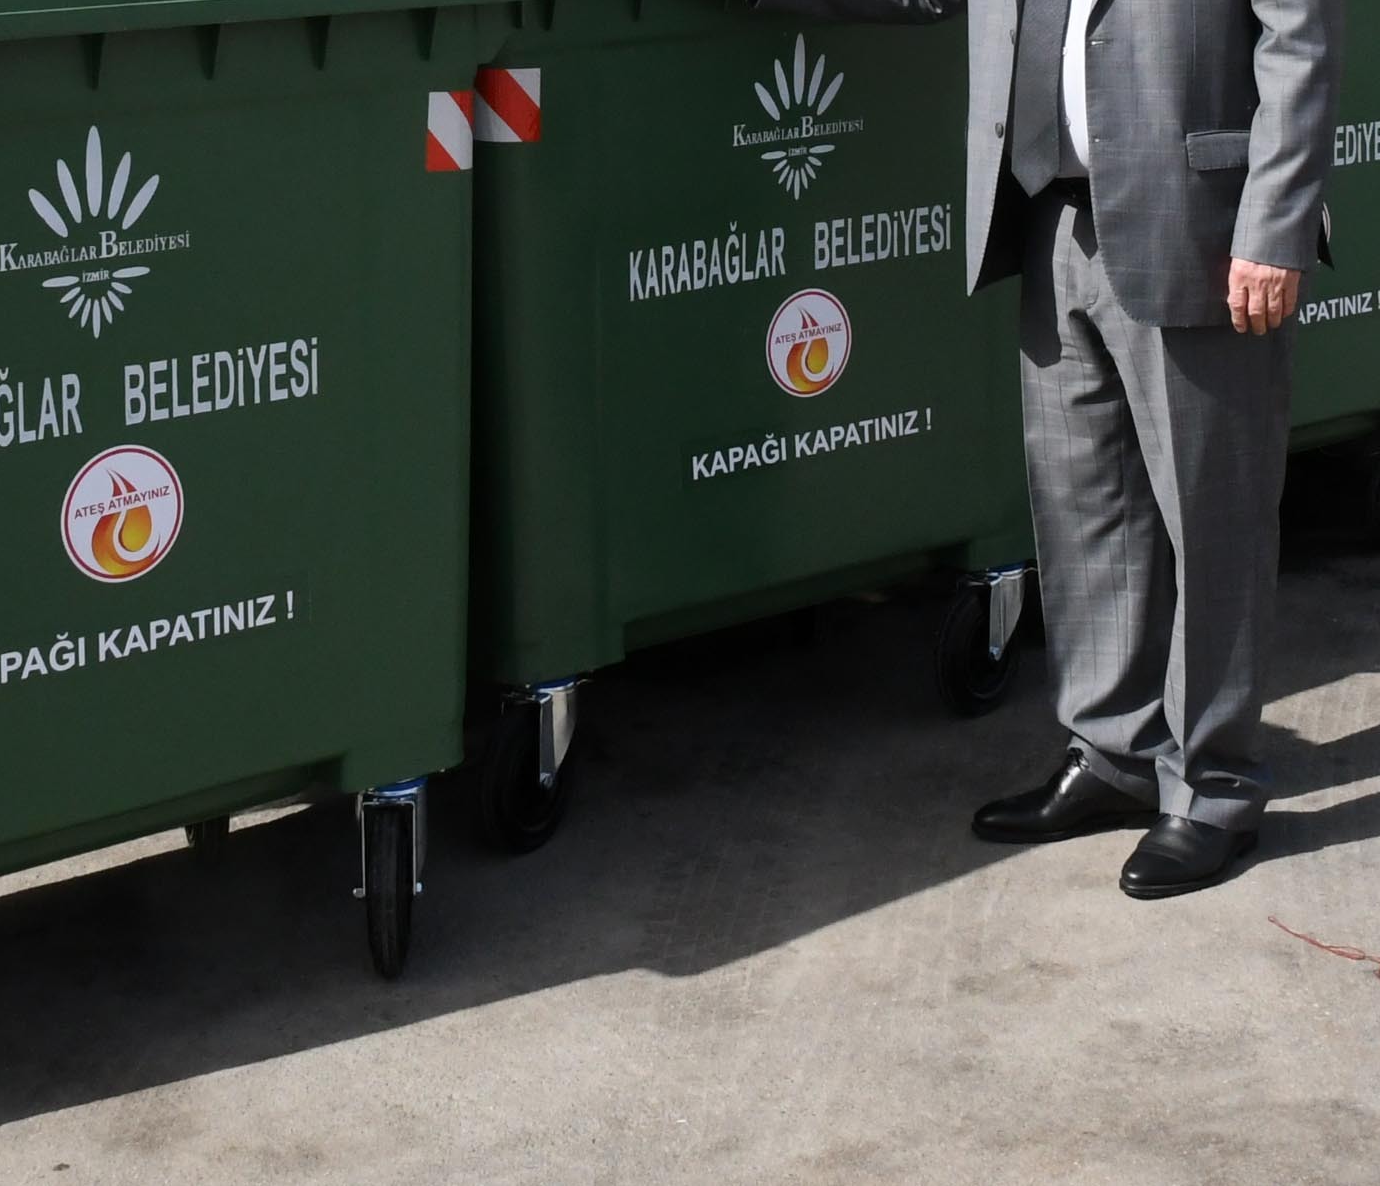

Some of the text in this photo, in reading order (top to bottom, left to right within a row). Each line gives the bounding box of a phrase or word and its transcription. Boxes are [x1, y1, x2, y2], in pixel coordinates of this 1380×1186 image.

[0, 229, 190, 272] KARABAĞLAR BELEDİYESİ
[630, 221, 785, 301] KARABAĞLAR
[82, 268, 110, 283] İZMİR
[1298, 291, 1373, 325] APATINIZ
[775, 322, 842, 345] ATEŞ ATMAYINIZ
[692, 407, 932, 481] KAPAĞI KAPATINIZ !
[74, 485, 170, 520] ATEŞ ATMAYINIZ
[98, 594, 277, 663] KAPATINIZ
[286, 590, 294, 620] !
